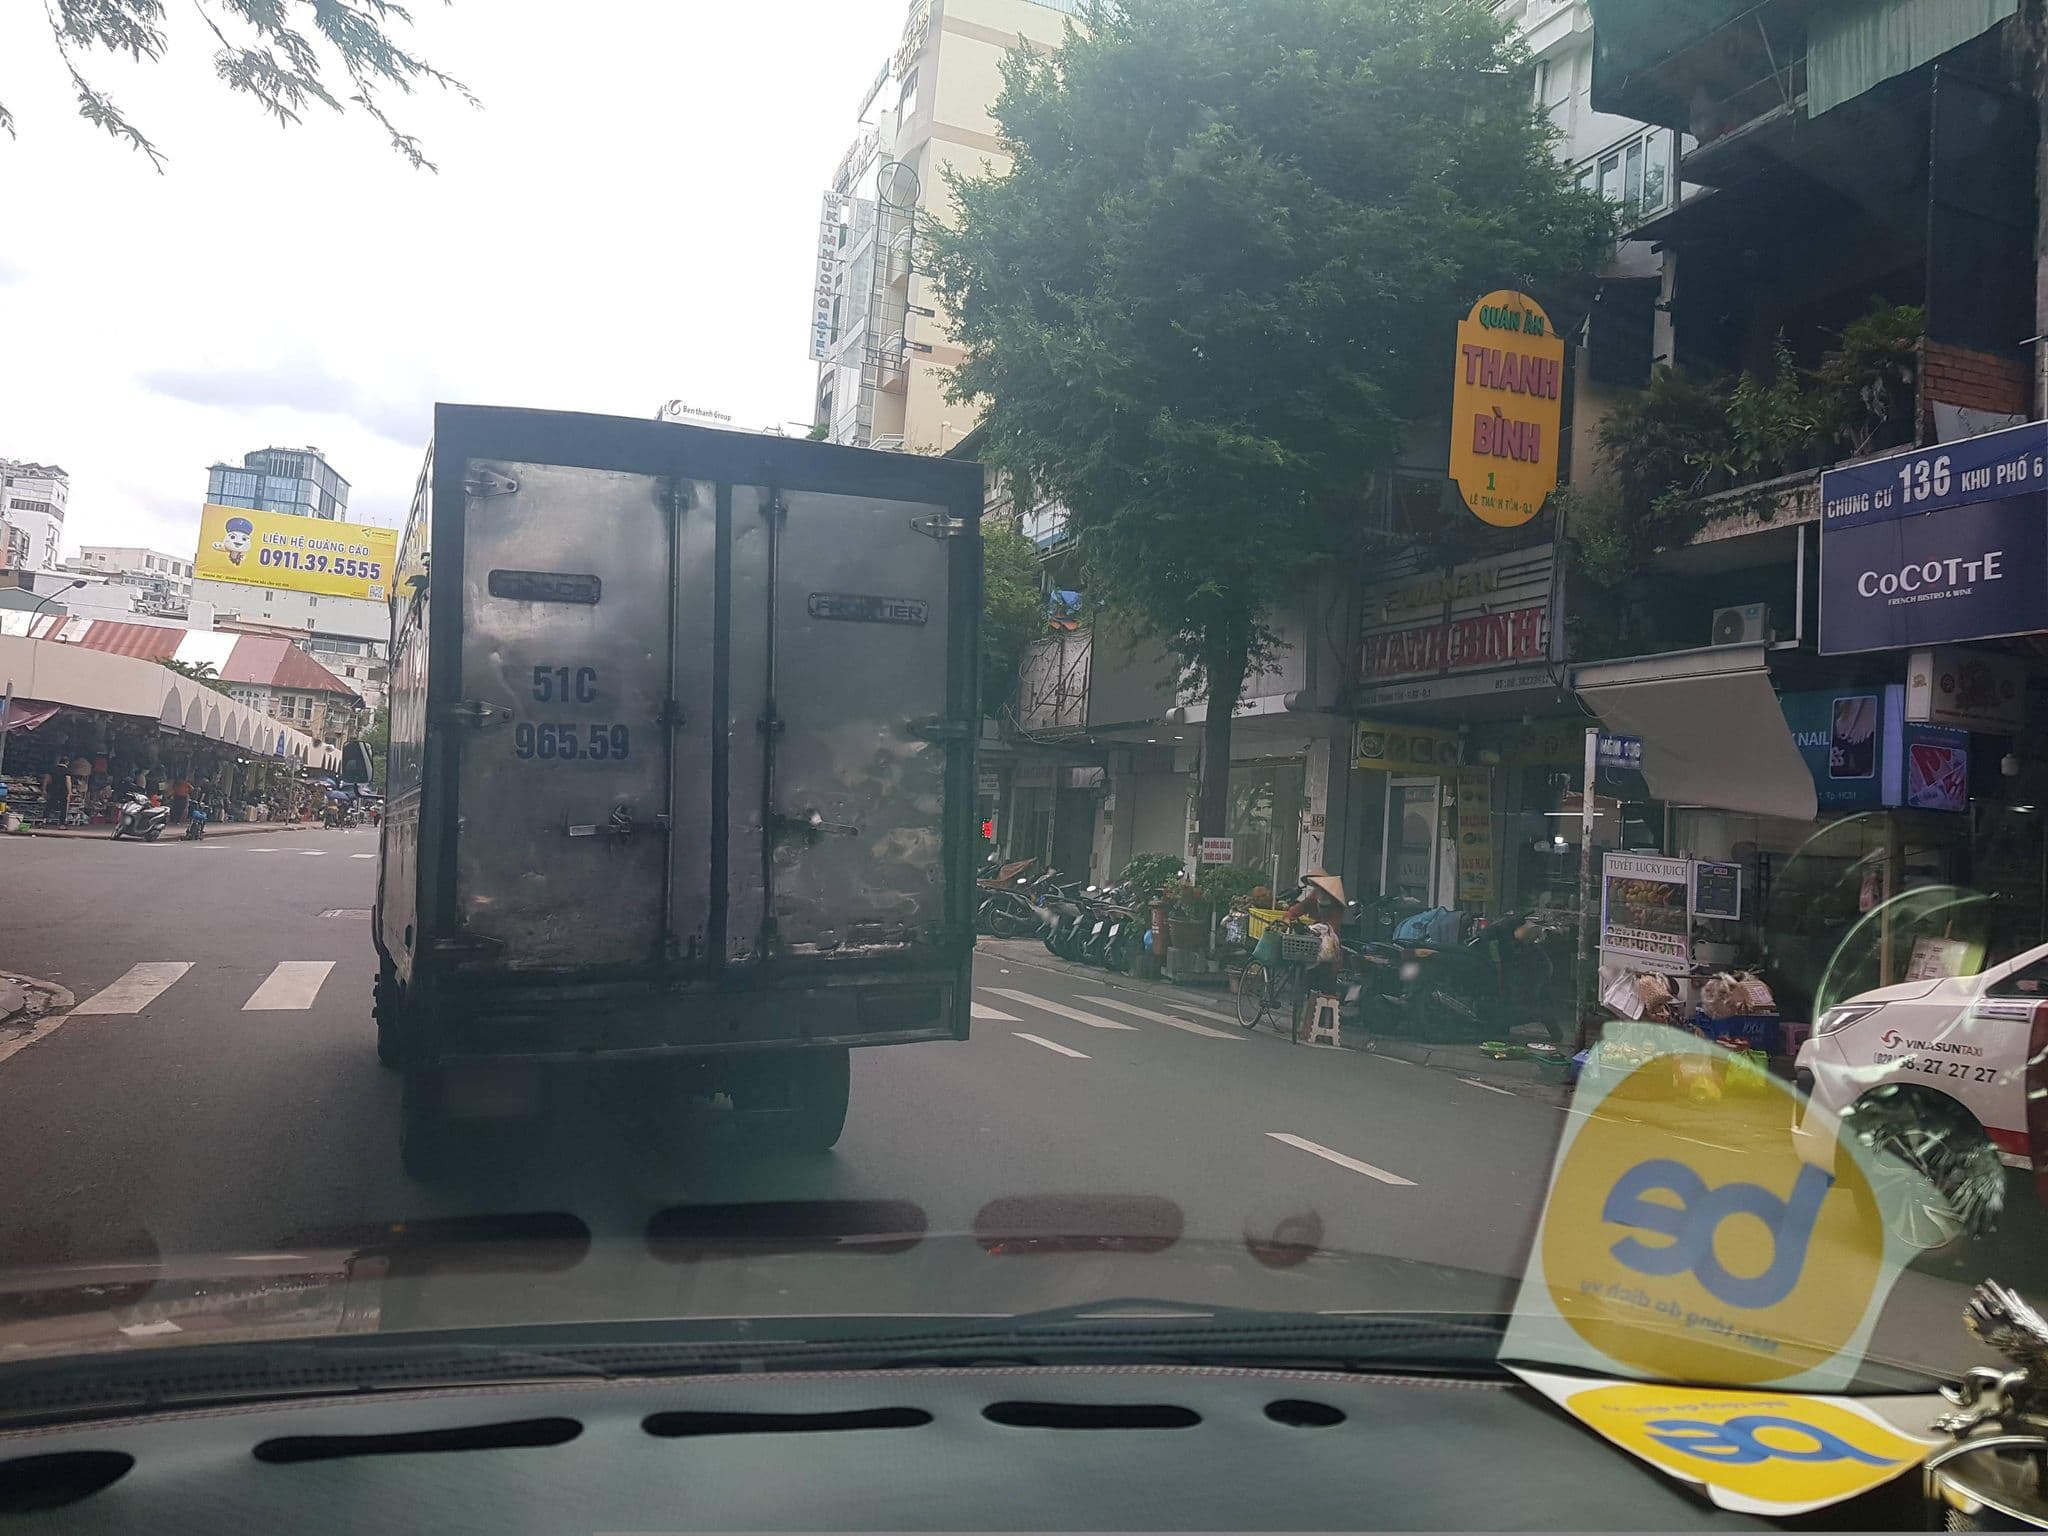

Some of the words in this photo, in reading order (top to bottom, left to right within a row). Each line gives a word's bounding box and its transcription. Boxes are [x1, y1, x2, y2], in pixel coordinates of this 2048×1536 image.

[1479, 304, 1520, 331] QUÁN
[1523, 309, 1544, 336] ĂN
[1462, 344, 1559, 399] THANH
[1473, 405, 1541, 463] BÌNH
[1487, 472, 1495, 490] 1
[1828, 493, 1869, 518] CHUNG
[1875, 485, 1893, 509] CƯ
[1899, 455, 1951, 504] 136
[1961, 467, 1990, 492] KHU
[1996, 451, 2030, 485] PHỐ
[2033, 457, 2043, 477] 6
[263, 532, 287, 545] LIÊN
[290, 535, 304, 549] HỆ
[259, 548, 381, 580] 0911.39.5555
[1917, 592, 1944, 602] BISTRO
[1945, 590, 1952, 598] &
[533, 666, 597, 703] 51C
[515, 723, 630, 760] 965.59
[1798, 732, 1830, 746] NAIL
[1636, 862, 1662, 874] LUCKY
[1923, 1058, 1943, 1075] 27
[1948, 1063, 1971, 1079] 27
[1974, 1067, 1997, 1083] 27
